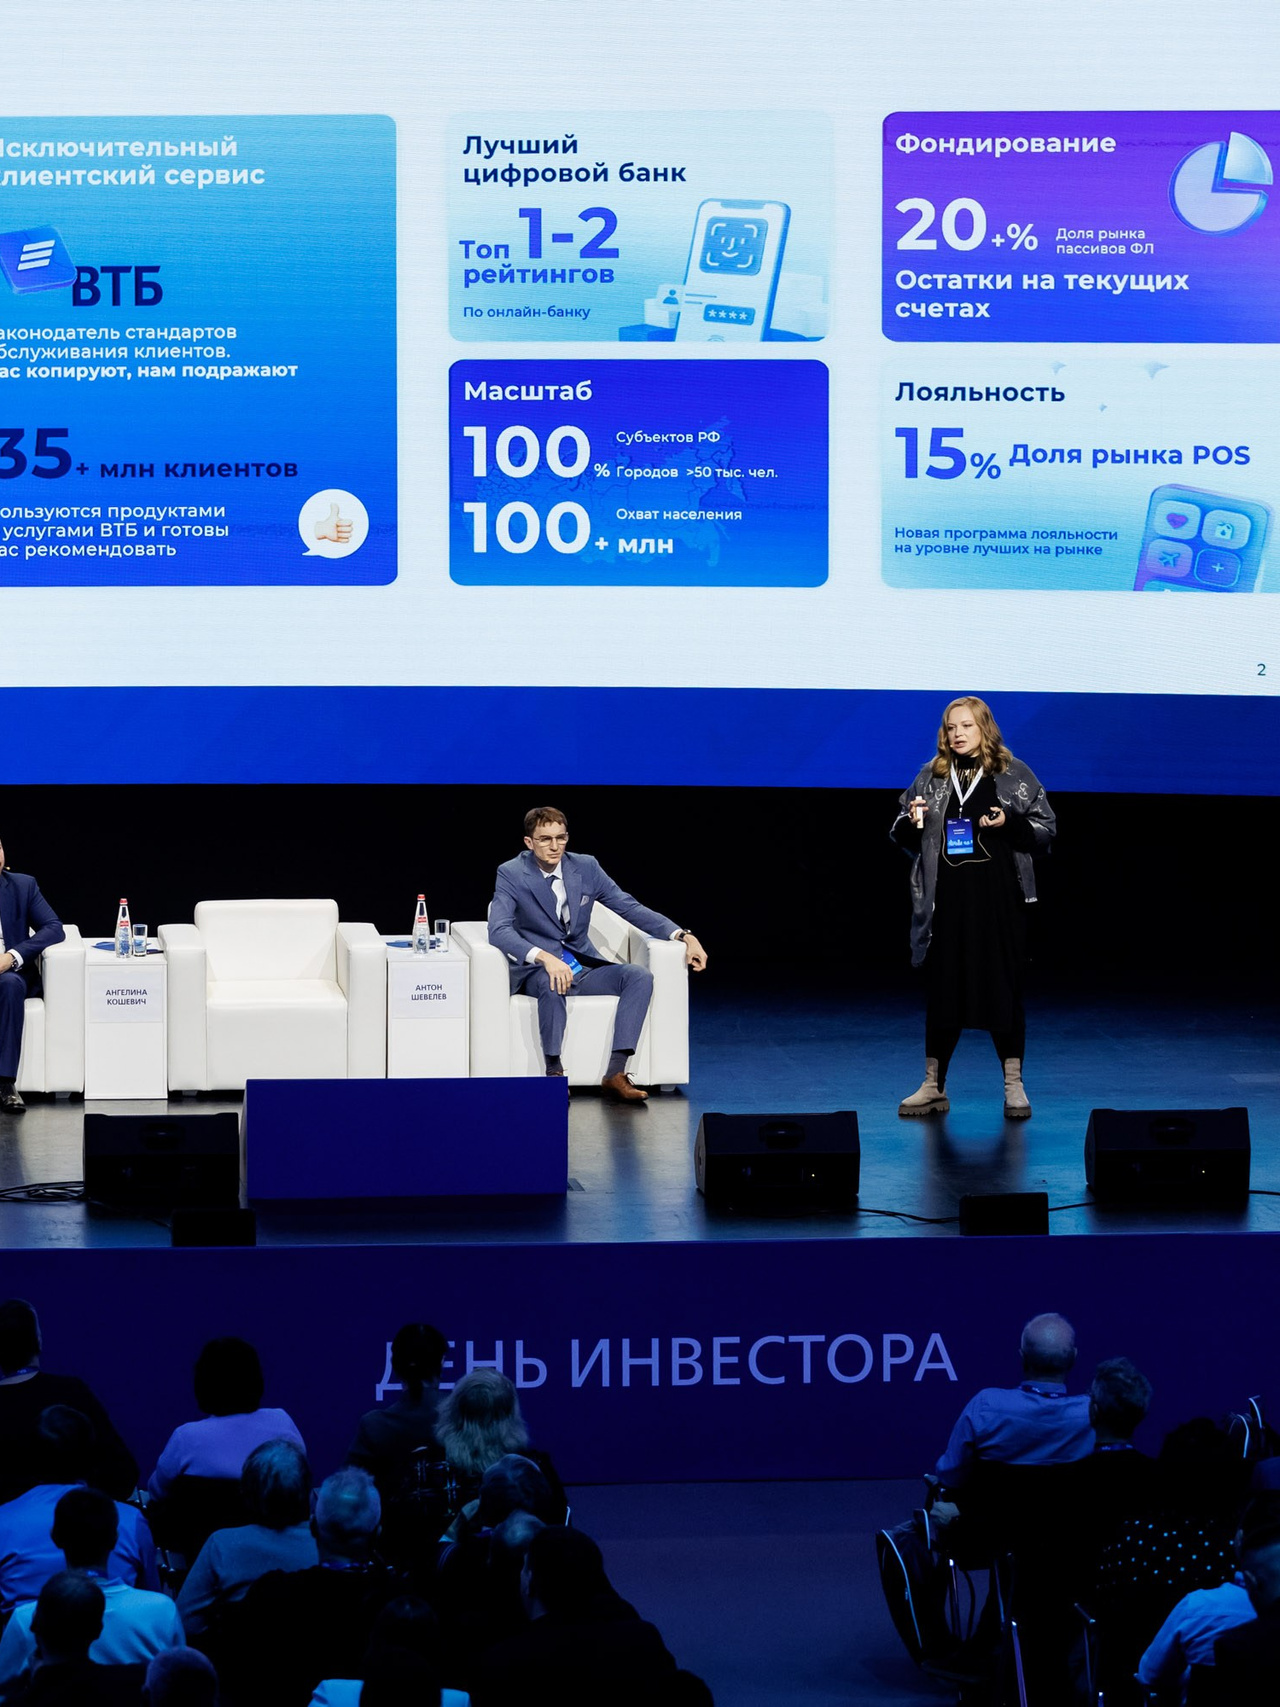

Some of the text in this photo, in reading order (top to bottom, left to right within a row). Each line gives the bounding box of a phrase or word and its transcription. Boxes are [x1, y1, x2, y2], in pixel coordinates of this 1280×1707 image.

[463, 134, 578, 159] Лучший
[895, 132, 1116, 158] Фондирование
[165, 166, 265, 188] сервис
[463, 162, 686, 187] цифровой банк
[459, 207, 619, 260] Топ 1-2
[1056, 228, 1145, 242] Доля рынка
[1056, 242, 1154, 255] пассивов ФЛ
[464, 263, 614, 288] рейтингов
[895, 270, 1189, 294] Остатки на текущих
[72, 266, 164, 307] ВТБ
[463, 305, 591, 320] По онлайн-банку
[895, 300, 990, 318] счетах
[125, 326, 237, 342] стандартов
[133, 344, 231, 360] клиентов.
[26, 364, 132, 382] копируют,
[137, 364, 177, 379] нам
[181, 363, 298, 382] подражают
[464, 379, 593, 402] Масштаб
[895, 382, 1065, 402] Лояльность
[616, 430, 721, 444] Субъектов РФ
[1009, 444, 1082, 466] Доля
[1092, 447, 1183, 468] рынка
[1192, 445, 1251, 465] POS
[99, 462, 155, 479] млн
[164, 460, 298, 479] клиентов
[616, 466, 678, 479] Городов
[715, 468, 744, 479] тыс.
[749, 468, 778, 478] чел.
[107, 504, 226, 523] продуктами
[616, 508, 742, 520] Охват населения
[1, 525, 95, 541] услугами
[100, 522, 138, 538] ВТБ
[143, 525, 156, 537] и
[161, 525, 229, 539] готовы
[894, 527, 1118, 542] Новая программа лояльности
[24, 543, 176, 560] рекомендовать
[618, 539, 673, 553] млн
[894, 543, 1103, 557] на уровне лучших на рынке
[1257, 663, 1266, 676] 2
[571, 1332, 958, 1388] ИНВЕСТОРА
